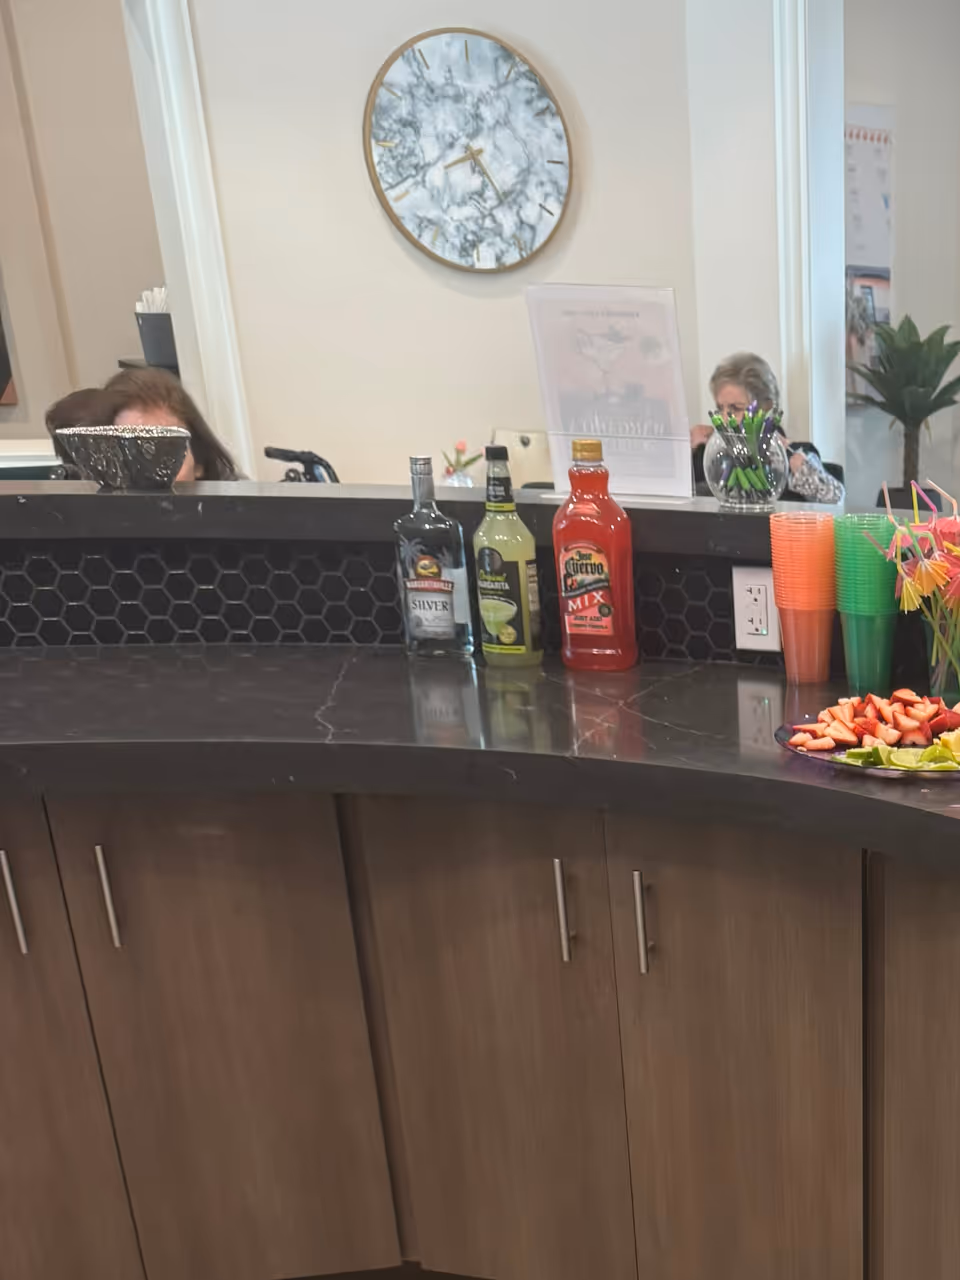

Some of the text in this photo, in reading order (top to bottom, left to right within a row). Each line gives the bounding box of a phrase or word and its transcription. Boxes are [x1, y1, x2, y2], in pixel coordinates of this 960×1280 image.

[564, 557, 604, 578] Cuervo
[411, 599, 449, 613] SILVER
[567, 591, 606, 612] MIX
